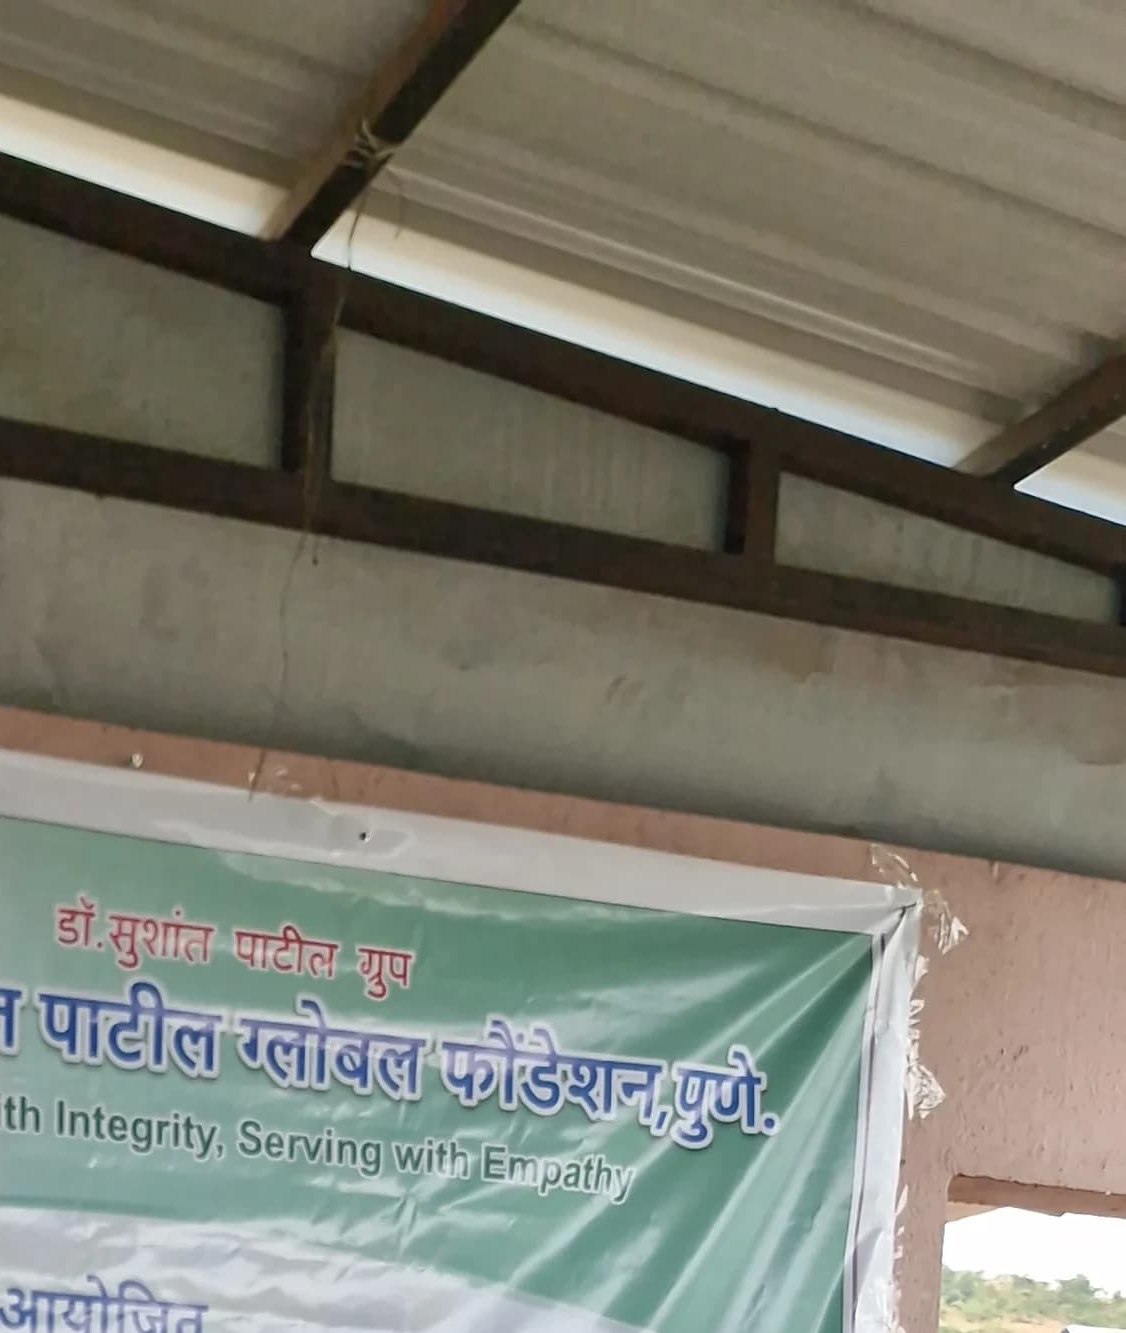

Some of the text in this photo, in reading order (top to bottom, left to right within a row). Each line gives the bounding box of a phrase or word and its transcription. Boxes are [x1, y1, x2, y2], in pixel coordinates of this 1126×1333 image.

[235, 925, 338, 979] पाटील
[357, 947, 412, 997] ग्रुप
[38, 983, 223, 1073] पाटील
[240, 999, 426, 1094] ग्लोबल
[56, 1101, 224, 1160] Integrity,
[240, 1120, 382, 1177] Serving
[395, 1139, 469, 1179] with
[483, 1146, 636, 1201] Empathy
